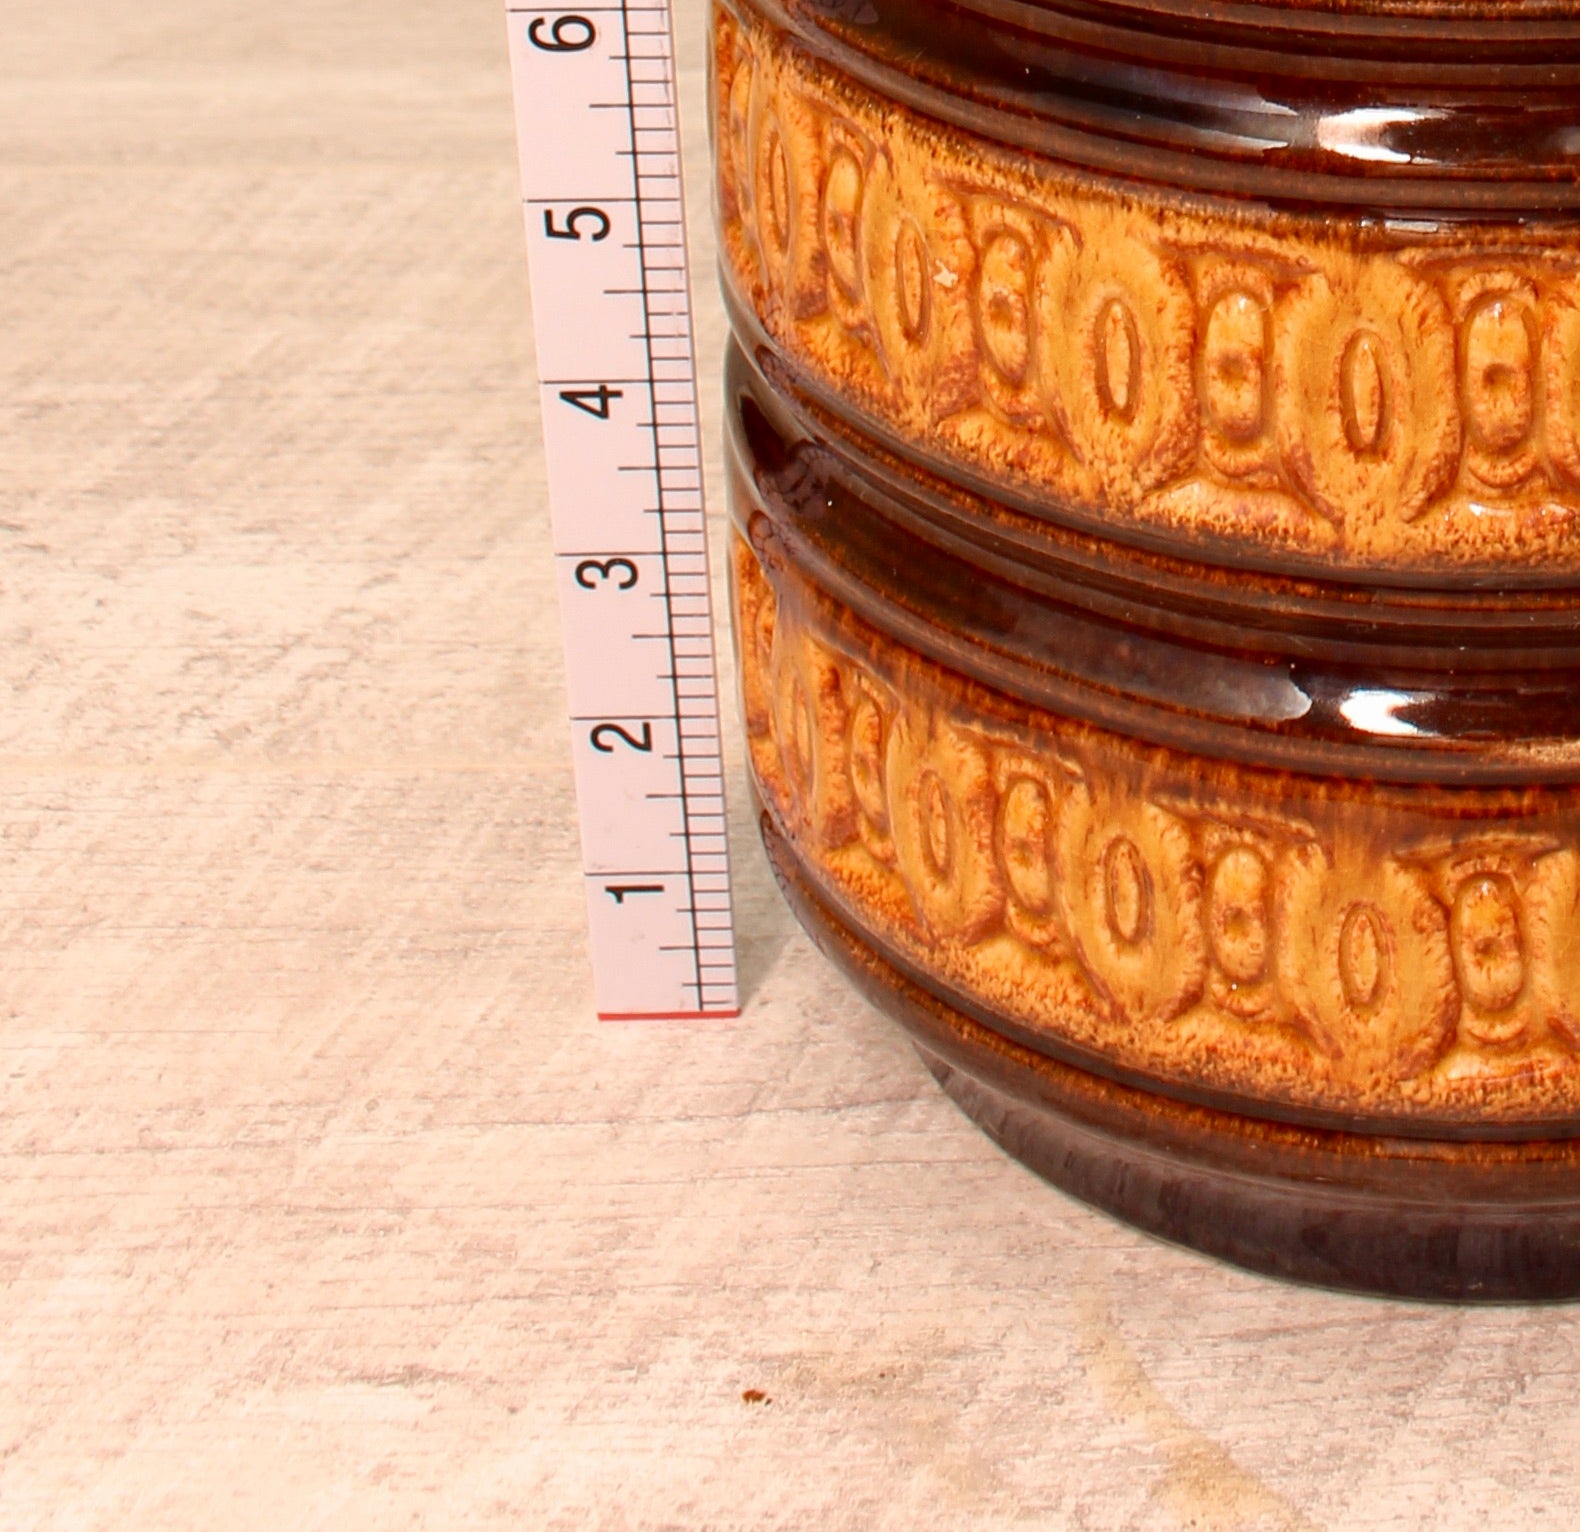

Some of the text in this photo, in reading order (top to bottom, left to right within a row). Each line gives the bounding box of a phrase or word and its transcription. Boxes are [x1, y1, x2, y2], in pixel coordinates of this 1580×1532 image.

[527, 14, 597, 53] 6
[543, 206, 612, 243] 5
[558, 384, 623, 419] 4
[575, 557, 640, 591] 3
[589, 721, 653, 754] 2
[604, 884, 665, 904] 1
